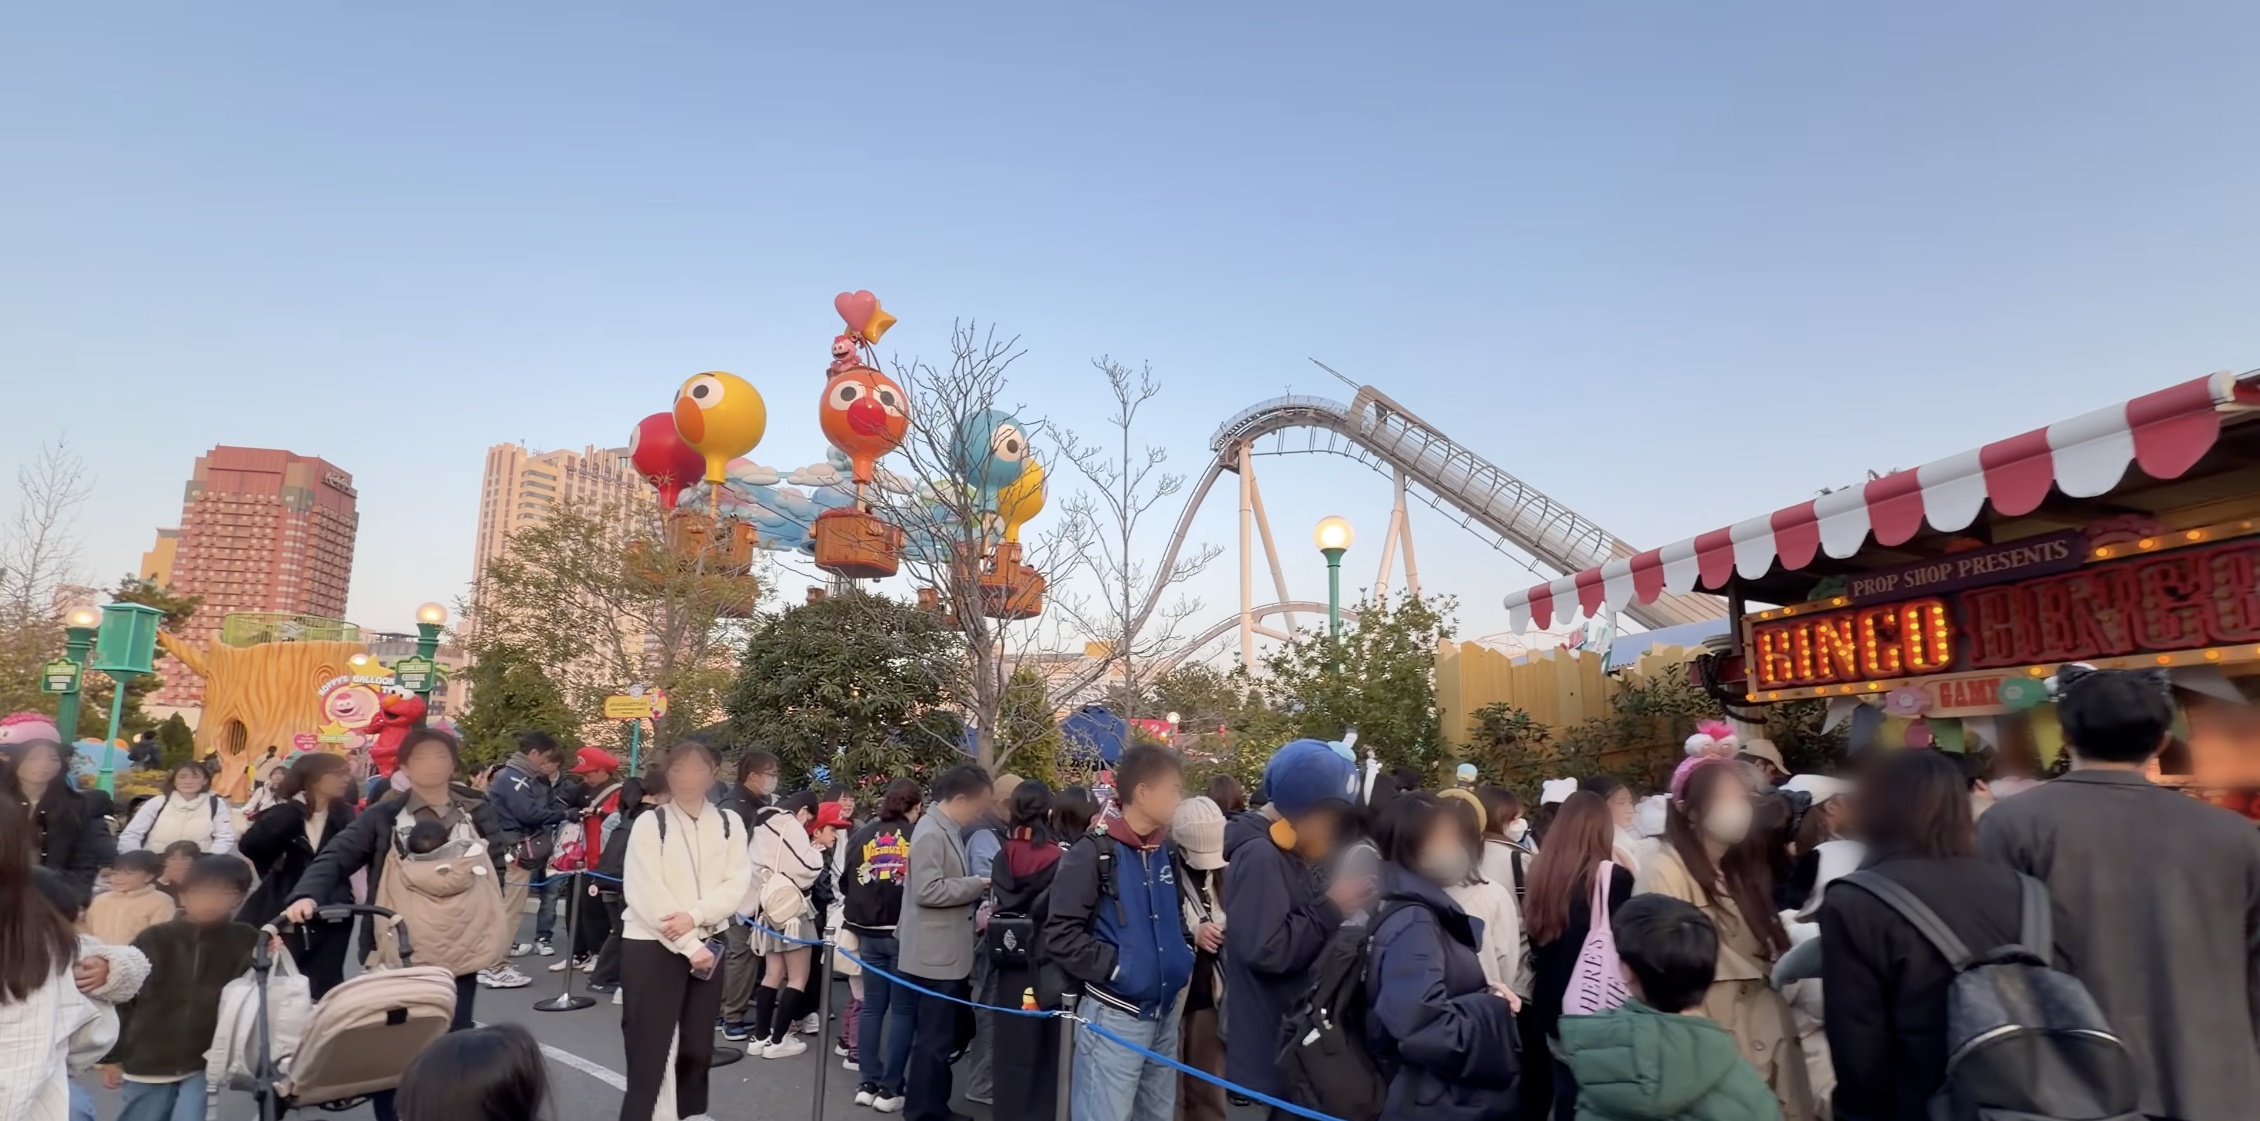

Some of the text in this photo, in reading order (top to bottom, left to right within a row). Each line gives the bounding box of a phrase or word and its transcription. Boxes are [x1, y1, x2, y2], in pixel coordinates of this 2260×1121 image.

[1853, 539, 2070, 597] PROP SHOP PRESENTS
[1754, 599, 1953, 688] BINGO
[352, 675, 395, 685] BALLOON
